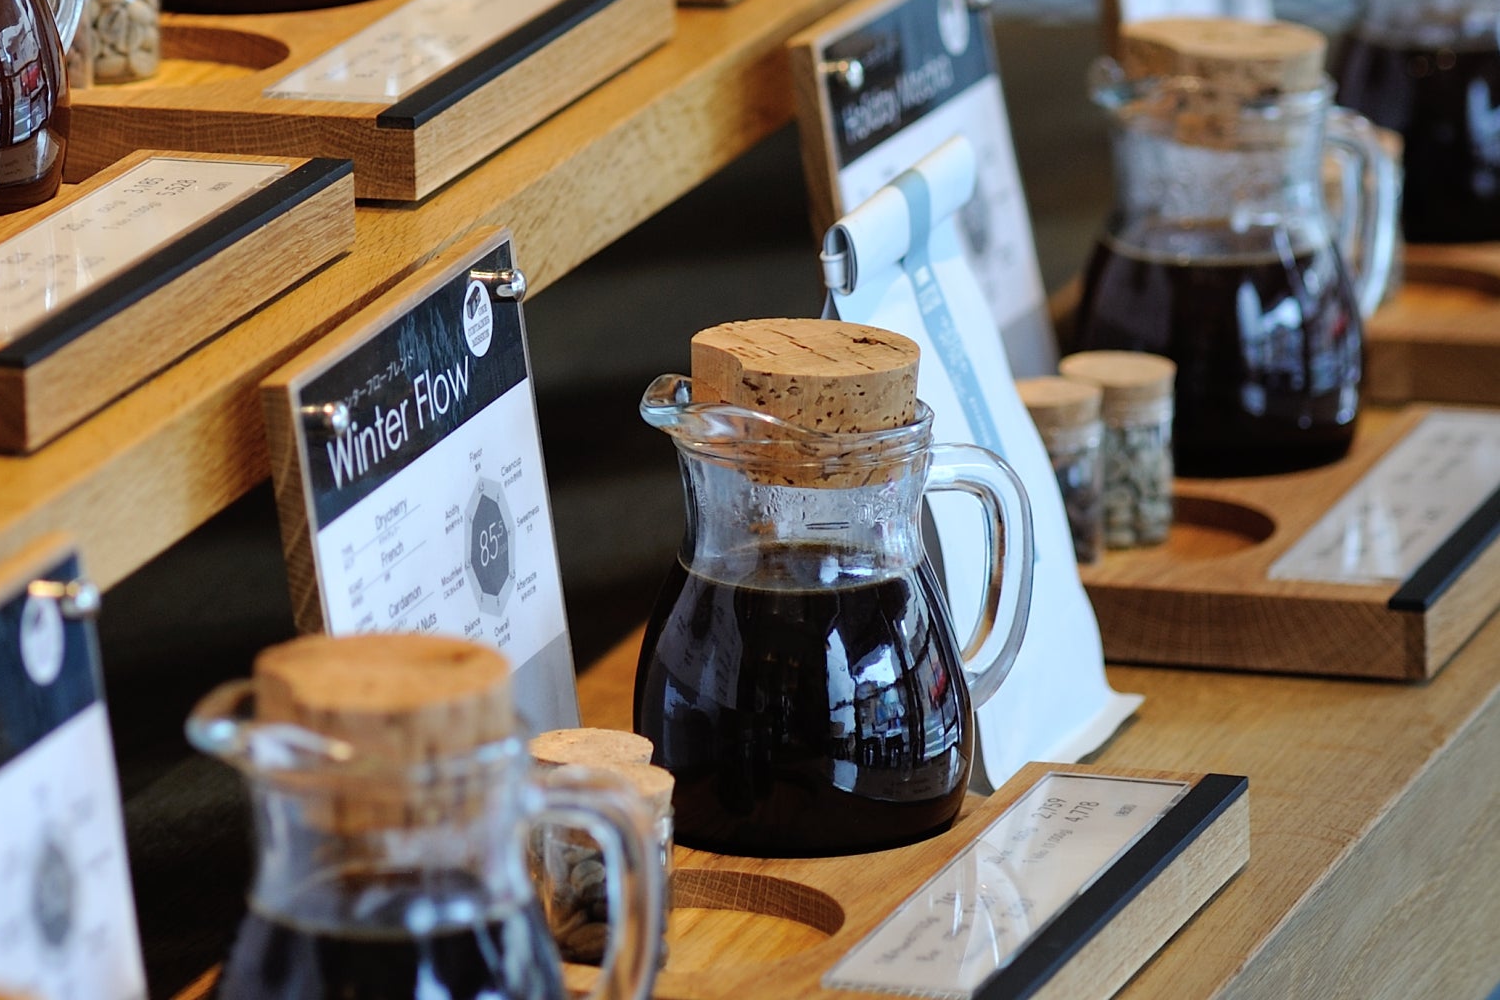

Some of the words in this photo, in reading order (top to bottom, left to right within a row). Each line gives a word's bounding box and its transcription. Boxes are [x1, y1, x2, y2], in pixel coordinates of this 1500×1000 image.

[326, 399, 408, 490] Winter
[413, 355, 469, 430] Flow
[380, 540, 404, 567] French
[1065, 800, 1100, 823] 4,778
